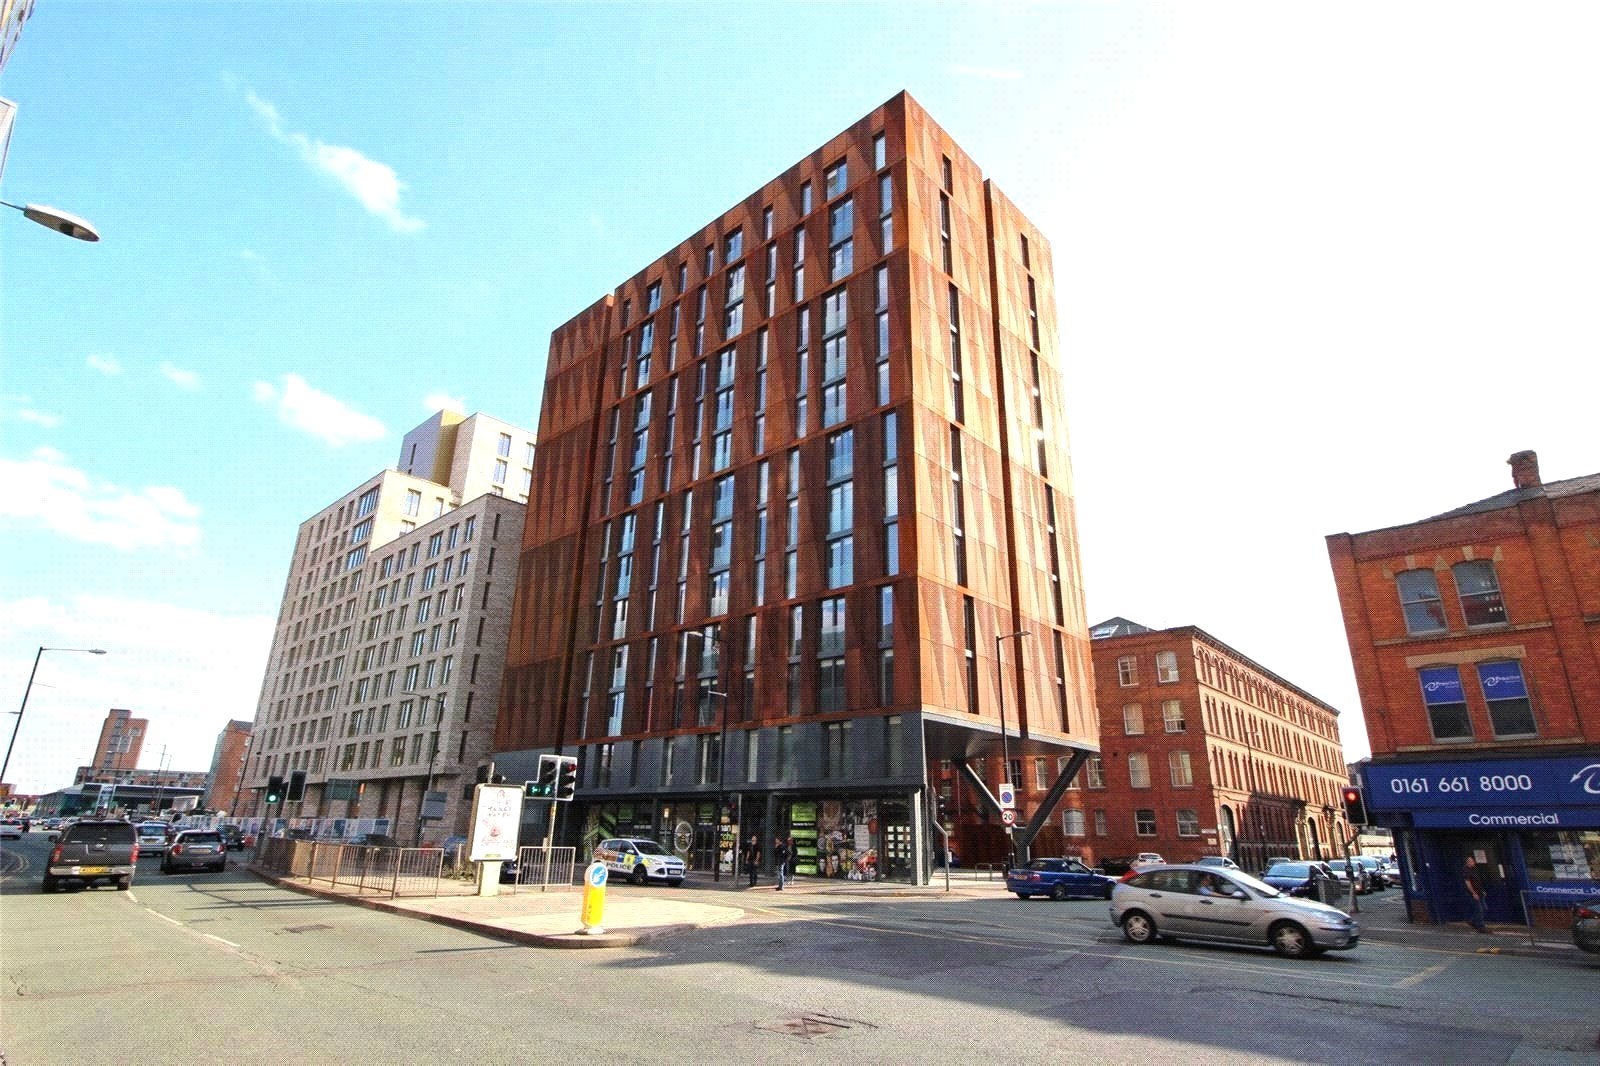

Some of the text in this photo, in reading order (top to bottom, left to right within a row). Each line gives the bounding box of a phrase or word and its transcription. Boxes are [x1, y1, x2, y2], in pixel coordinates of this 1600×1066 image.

[1390, 774, 1532, 793] 0161 661 8000
[1468, 813, 1560, 825] Commercial
[606, 862, 632, 870] POLICE
[1536, 886, 1585, 895] Commercial
